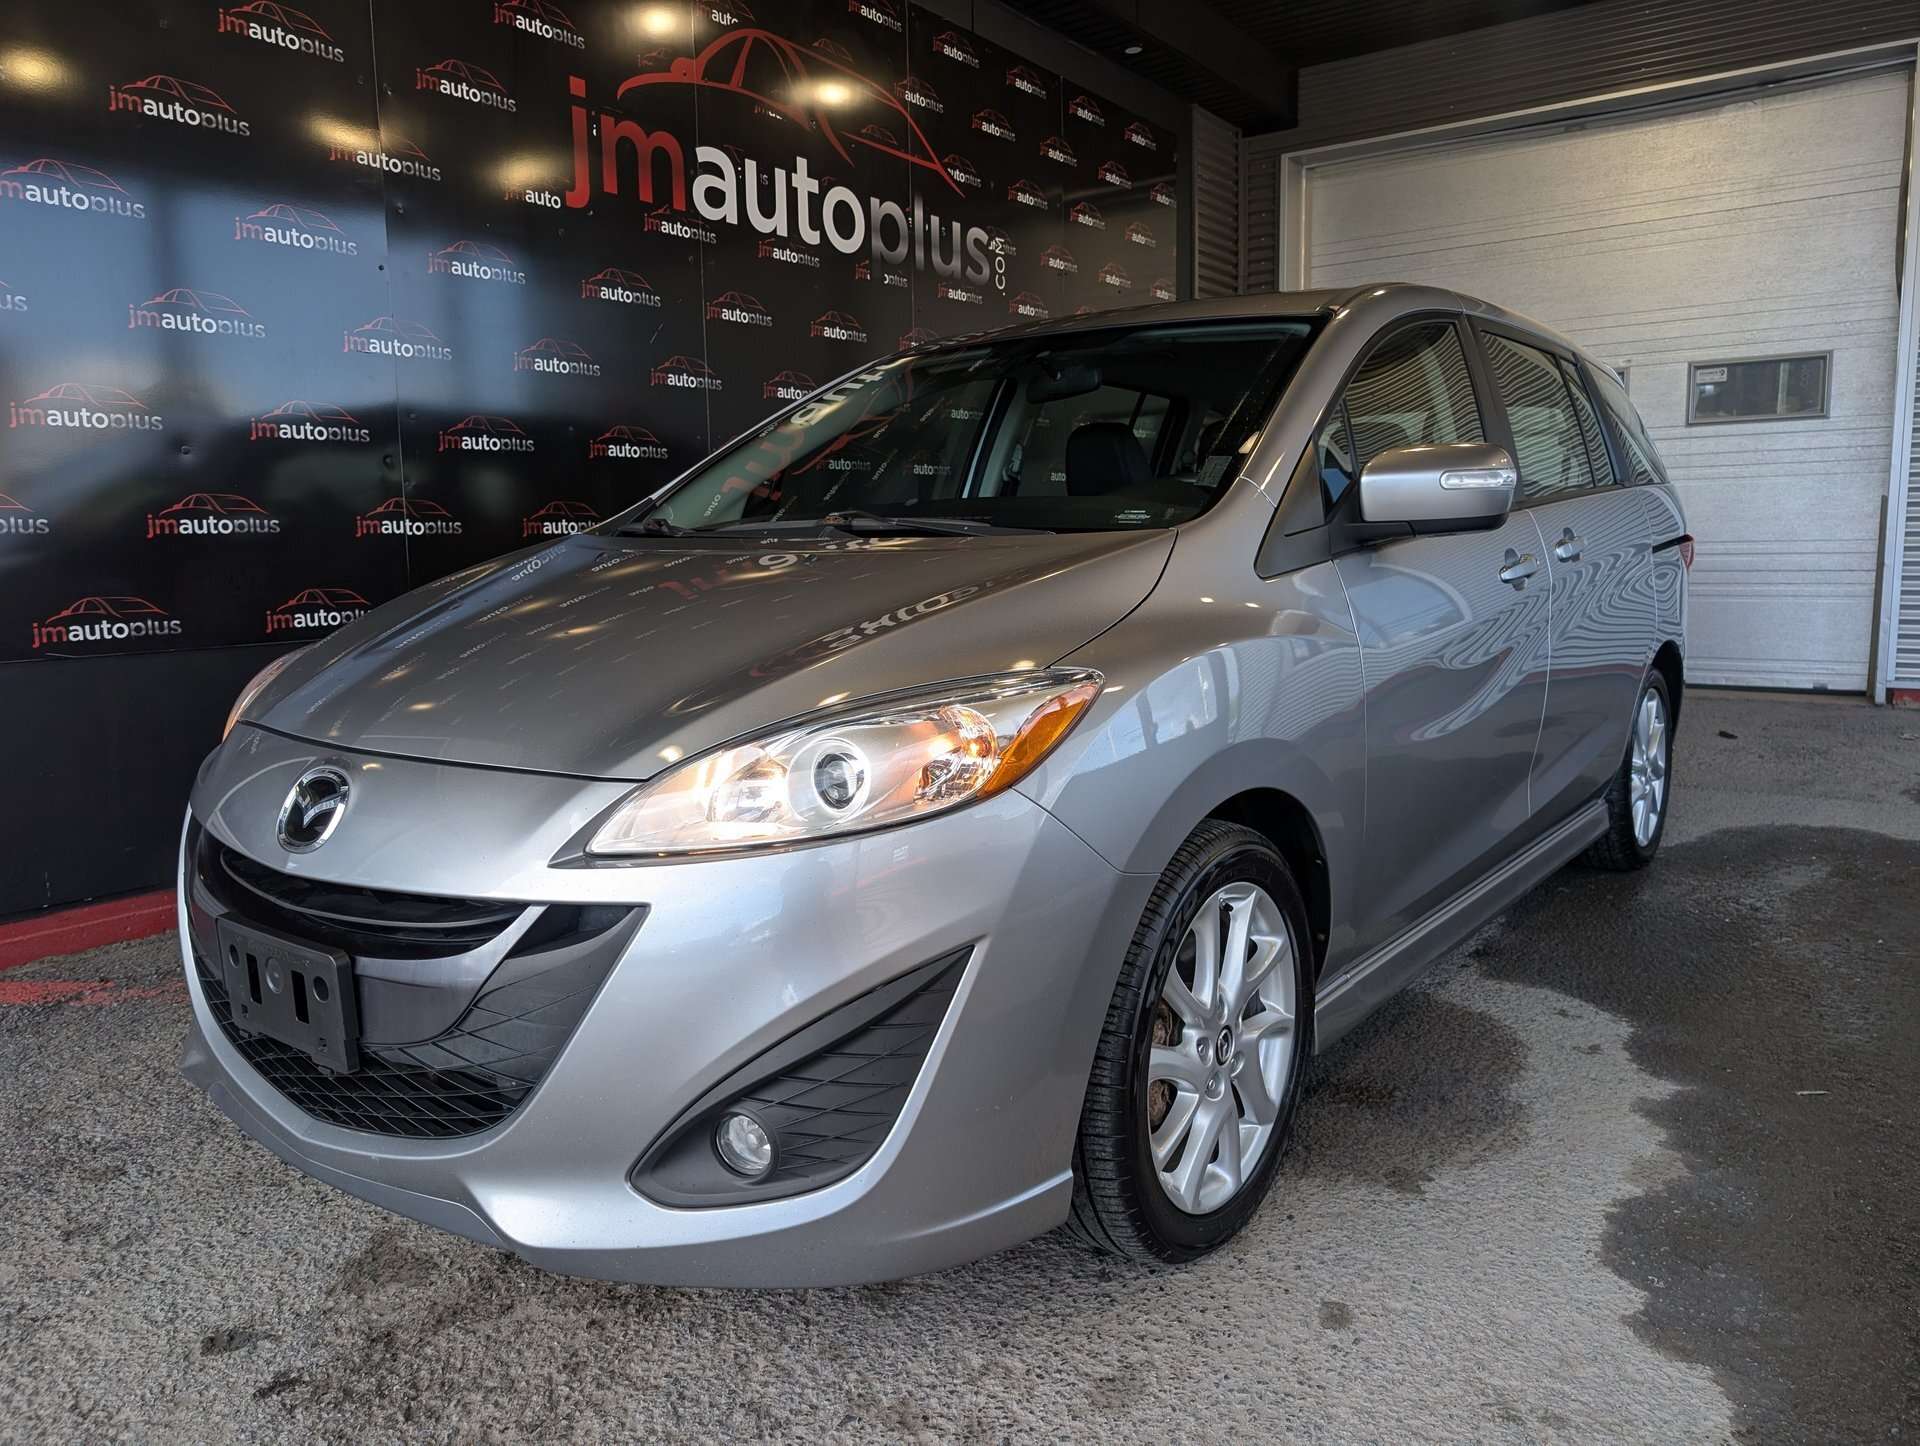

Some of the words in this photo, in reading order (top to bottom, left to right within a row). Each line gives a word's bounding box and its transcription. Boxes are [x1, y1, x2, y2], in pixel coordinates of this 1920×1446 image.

[218, 8, 345, 63] jmautoplus
[493, 3, 586, 49] jmautoplus
[416, 68, 517, 113] jmautoplus
[108, 85, 250, 137] jmautoplus
[565, 75, 991, 287] jmautoplus
[0, 179, 145, 219] mautoplus
[233, 217, 358, 256] jmautoplus
[644, 213, 718, 245] jmautoplus
[758, 240, 821, 269] jmautoplus
[427, 253, 527, 286] jmautoplus
[581, 280, 662, 308] jmautoplus
[128, 303, 266, 338] jmautoplus
[706, 303, 774, 328] jmautoplus
[343, 331, 454, 361] jmautoplus
[809, 320, 868, 344] jmautoplus
[513, 352, 601, 377] jmautoplus
[650, 368, 724, 392] jmautoplus
[9, 402, 164, 432] jmautoplus
[250, 418, 371, 443] jmautoplus
[438, 431, 536, 454] jmautoplus
[588, 440, 669, 460] jmautoplus
[146, 515, 281, 539] jmautoplus
[355, 515, 464, 538] jmautoplus
[32, 622, 183, 649] jmautoplus
